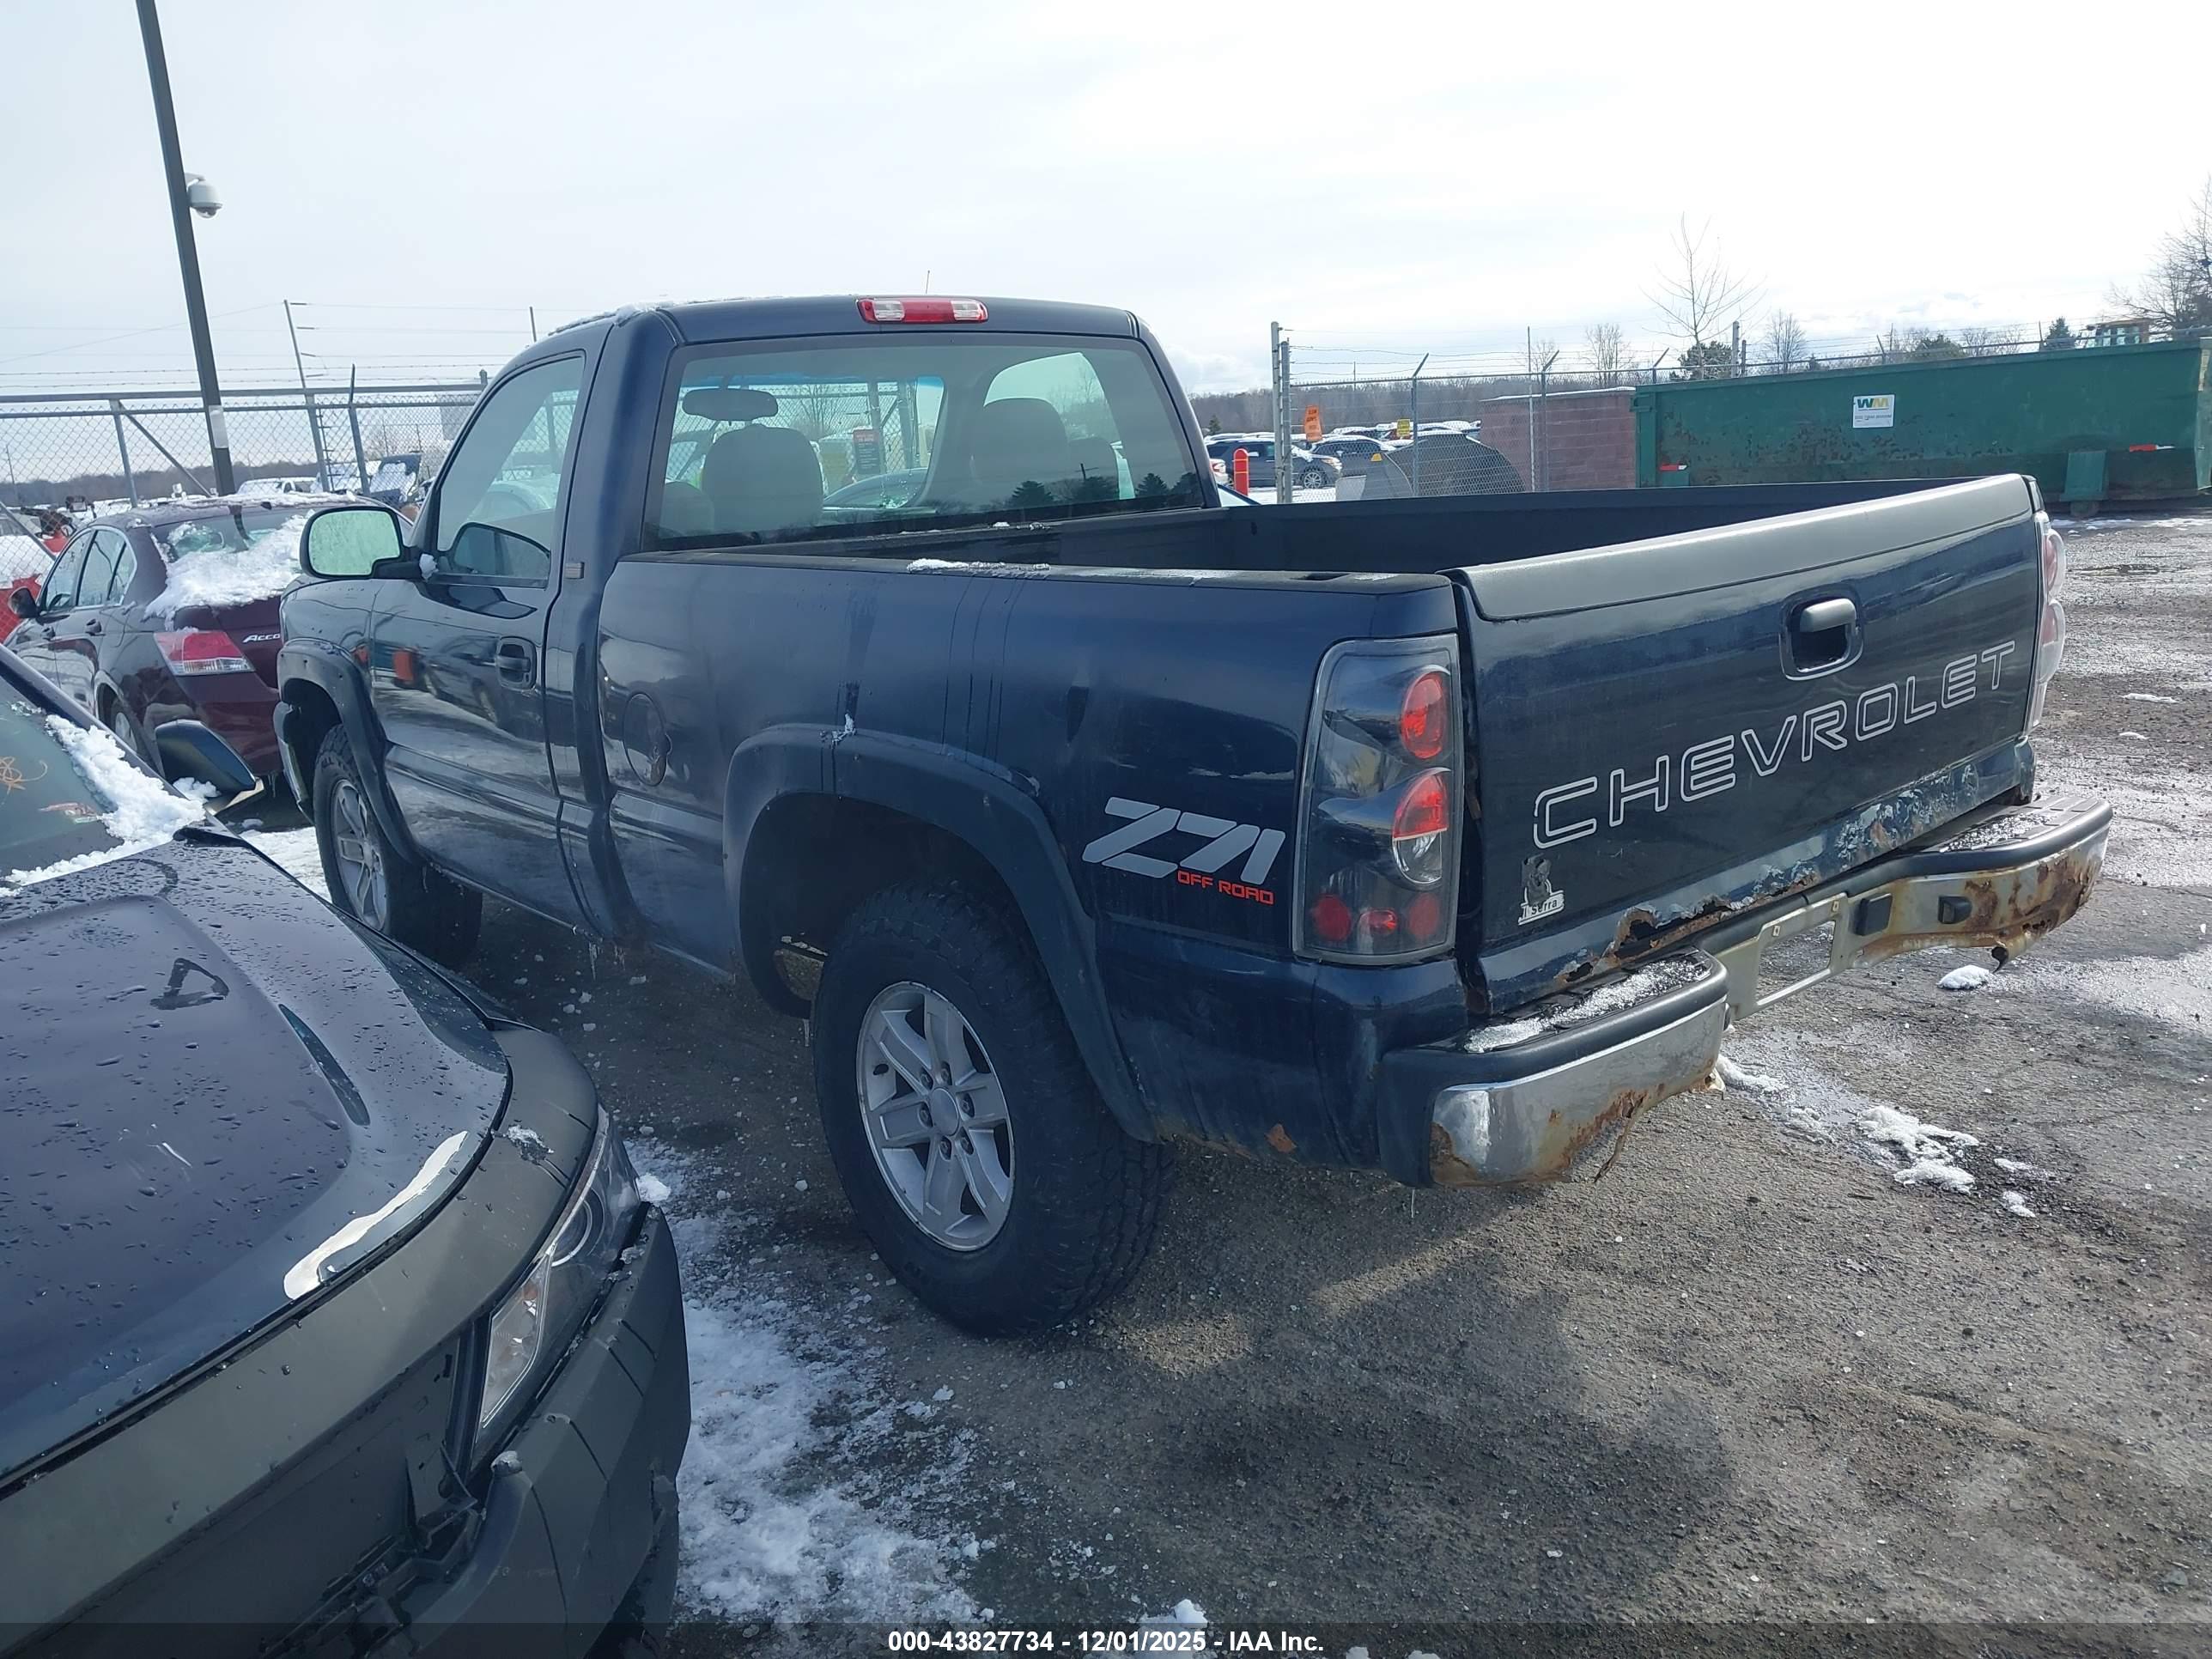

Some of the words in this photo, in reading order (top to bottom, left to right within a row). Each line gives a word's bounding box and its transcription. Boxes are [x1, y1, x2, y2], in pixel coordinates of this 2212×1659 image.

[1856, 398, 1889, 409] WM
[242, 633, 281, 643] ACCO
[1534, 640, 2016, 850] CHEVROLET
[1081, 796, 1286, 885] Z71
[1177, 870, 1214, 889] OFF
[1218, 879, 1274, 906] ROAD
